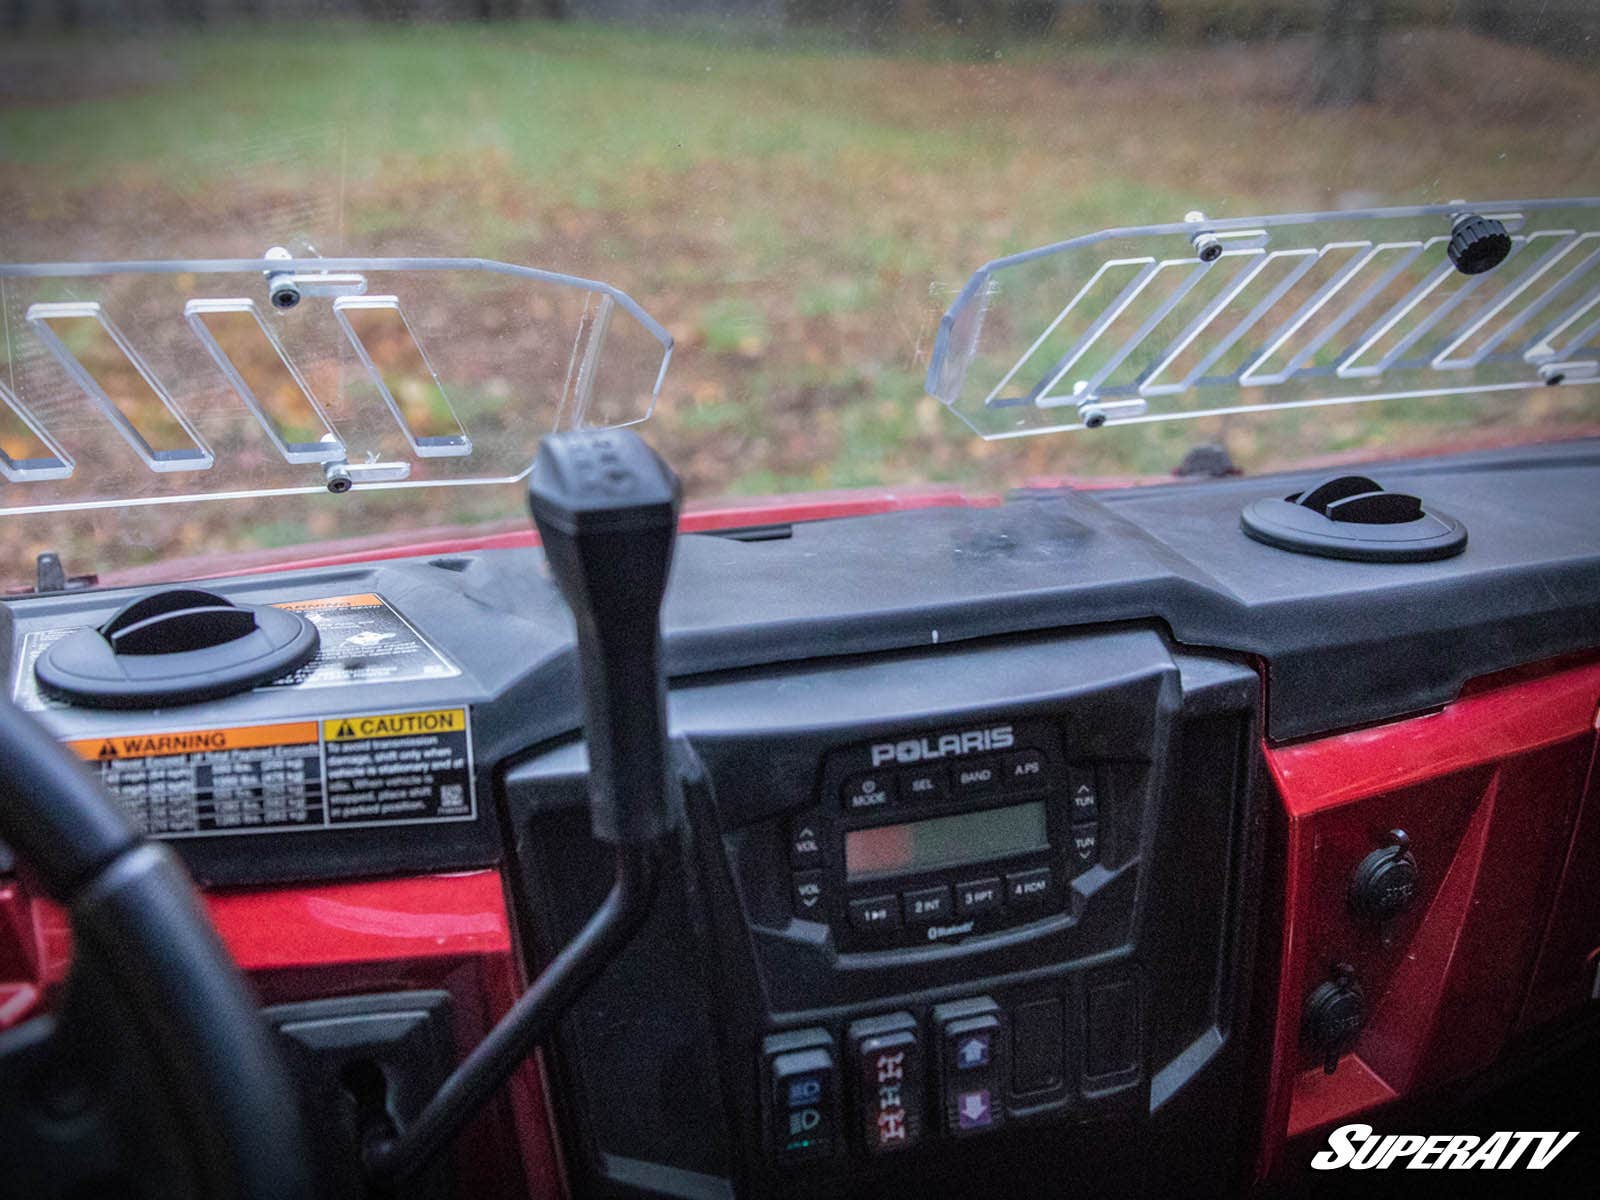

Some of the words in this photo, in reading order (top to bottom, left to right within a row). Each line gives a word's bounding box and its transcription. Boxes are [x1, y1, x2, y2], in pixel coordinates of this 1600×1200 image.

[360, 714, 453, 734] CAUTION
[123, 732, 227, 753] WARNING
[871, 726, 1014, 767] POLARIS
[960, 770, 992, 784] BAND
[912, 778, 933, 791] SEL
[853, 792, 886, 807] MODE
[1074, 796, 1095, 807] TUN
[796, 840, 818, 852] VOL
[1074, 837, 1095, 848] TUN
[799, 884, 820, 895] VOL
[1015, 884, 1023, 895] 4
[965, 893, 973, 905] 3
[915, 902, 922, 913] 2
